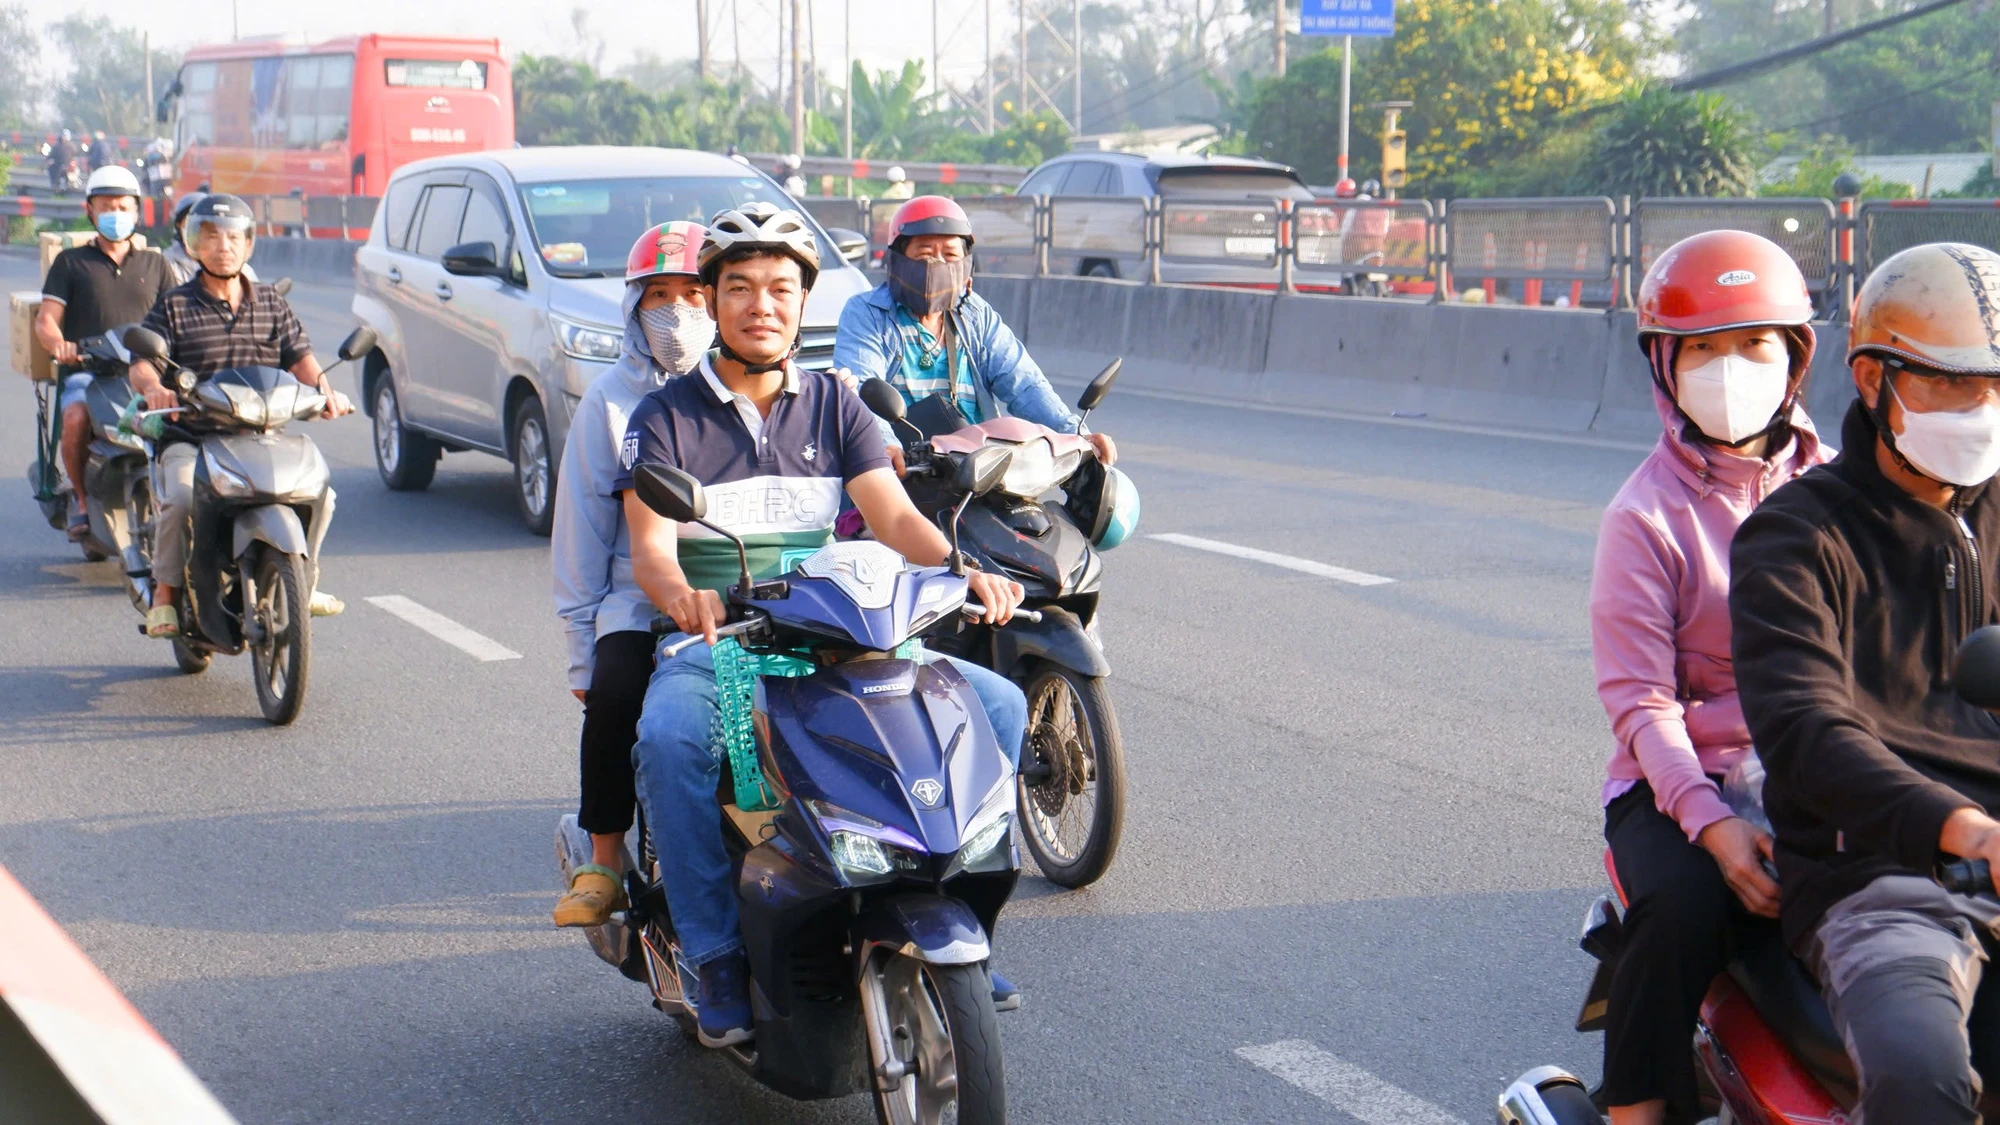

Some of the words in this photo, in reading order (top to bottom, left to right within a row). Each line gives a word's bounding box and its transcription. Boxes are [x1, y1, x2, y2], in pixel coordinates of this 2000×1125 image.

[1722, 272, 1751, 283] Asia
[715, 487, 816, 527] BHPC
[862, 683, 909, 694] HONDA
